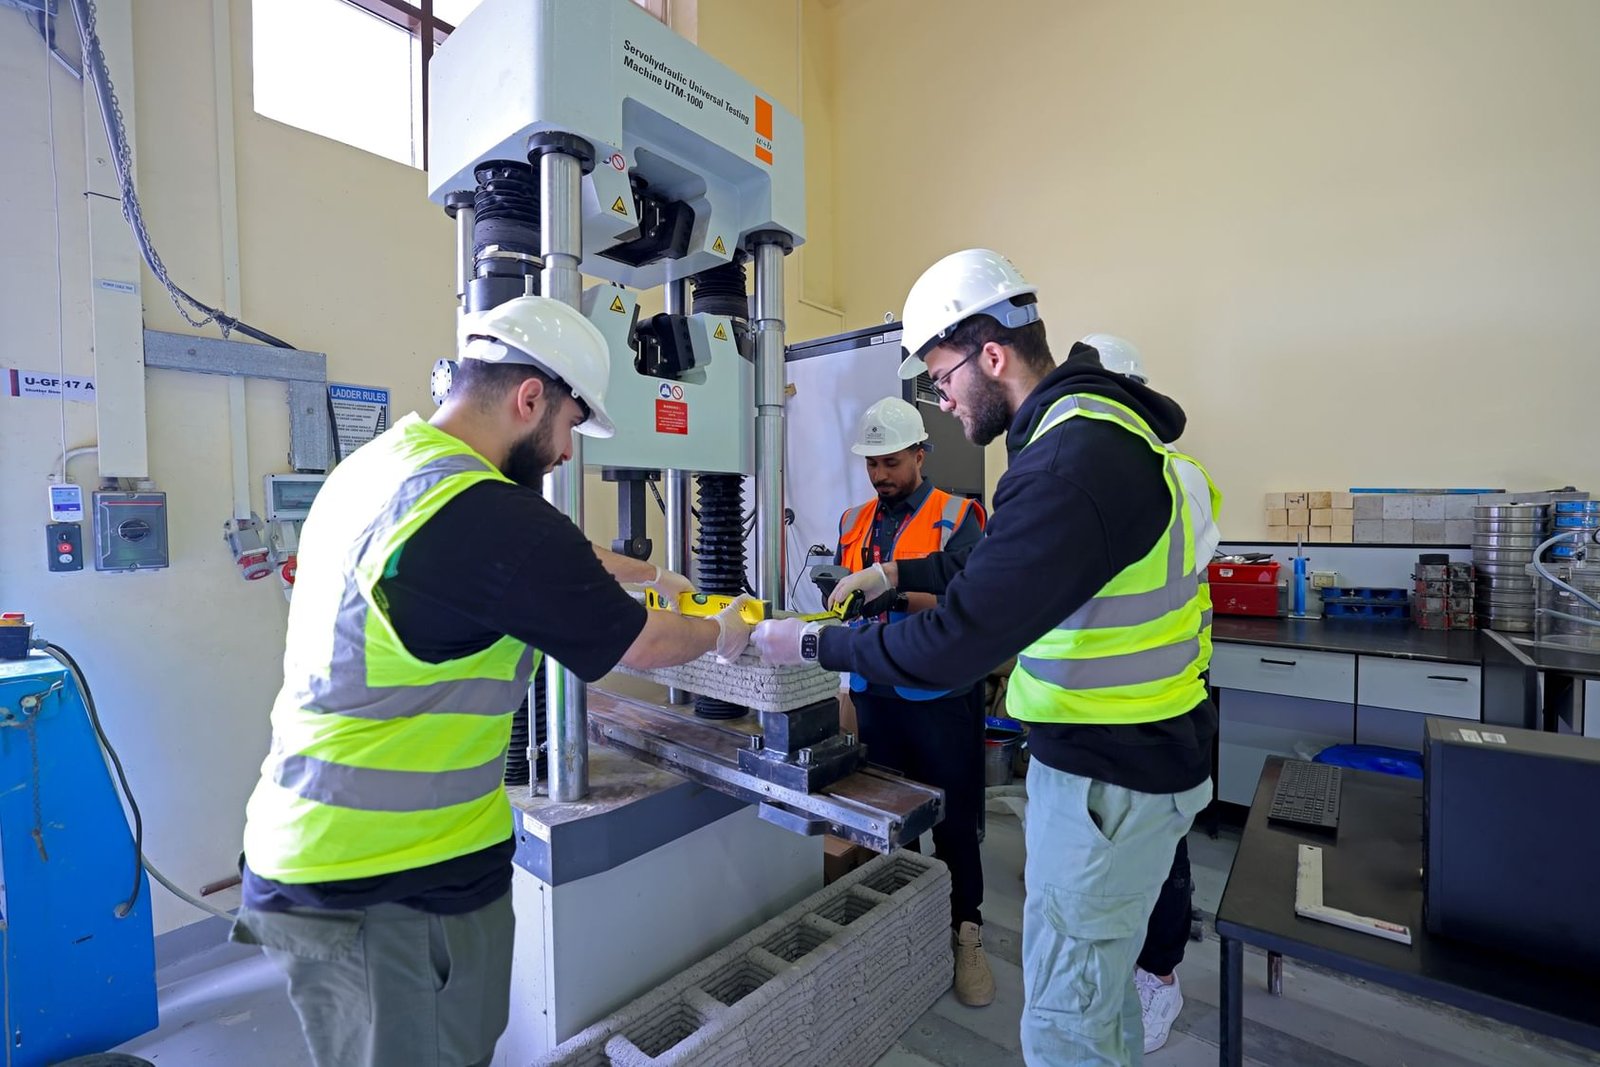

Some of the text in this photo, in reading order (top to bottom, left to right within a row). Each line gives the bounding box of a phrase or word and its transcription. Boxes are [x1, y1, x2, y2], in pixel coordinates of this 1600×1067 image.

[623, 39, 750, 125] Servohydraulic Universal Testing
[623, 55, 704, 110] Machine UTM-1000
[84, 382, 95, 391] A
[331, 387, 387, 402] LADDER RULES
[719, 602, 747, 612] STAY
